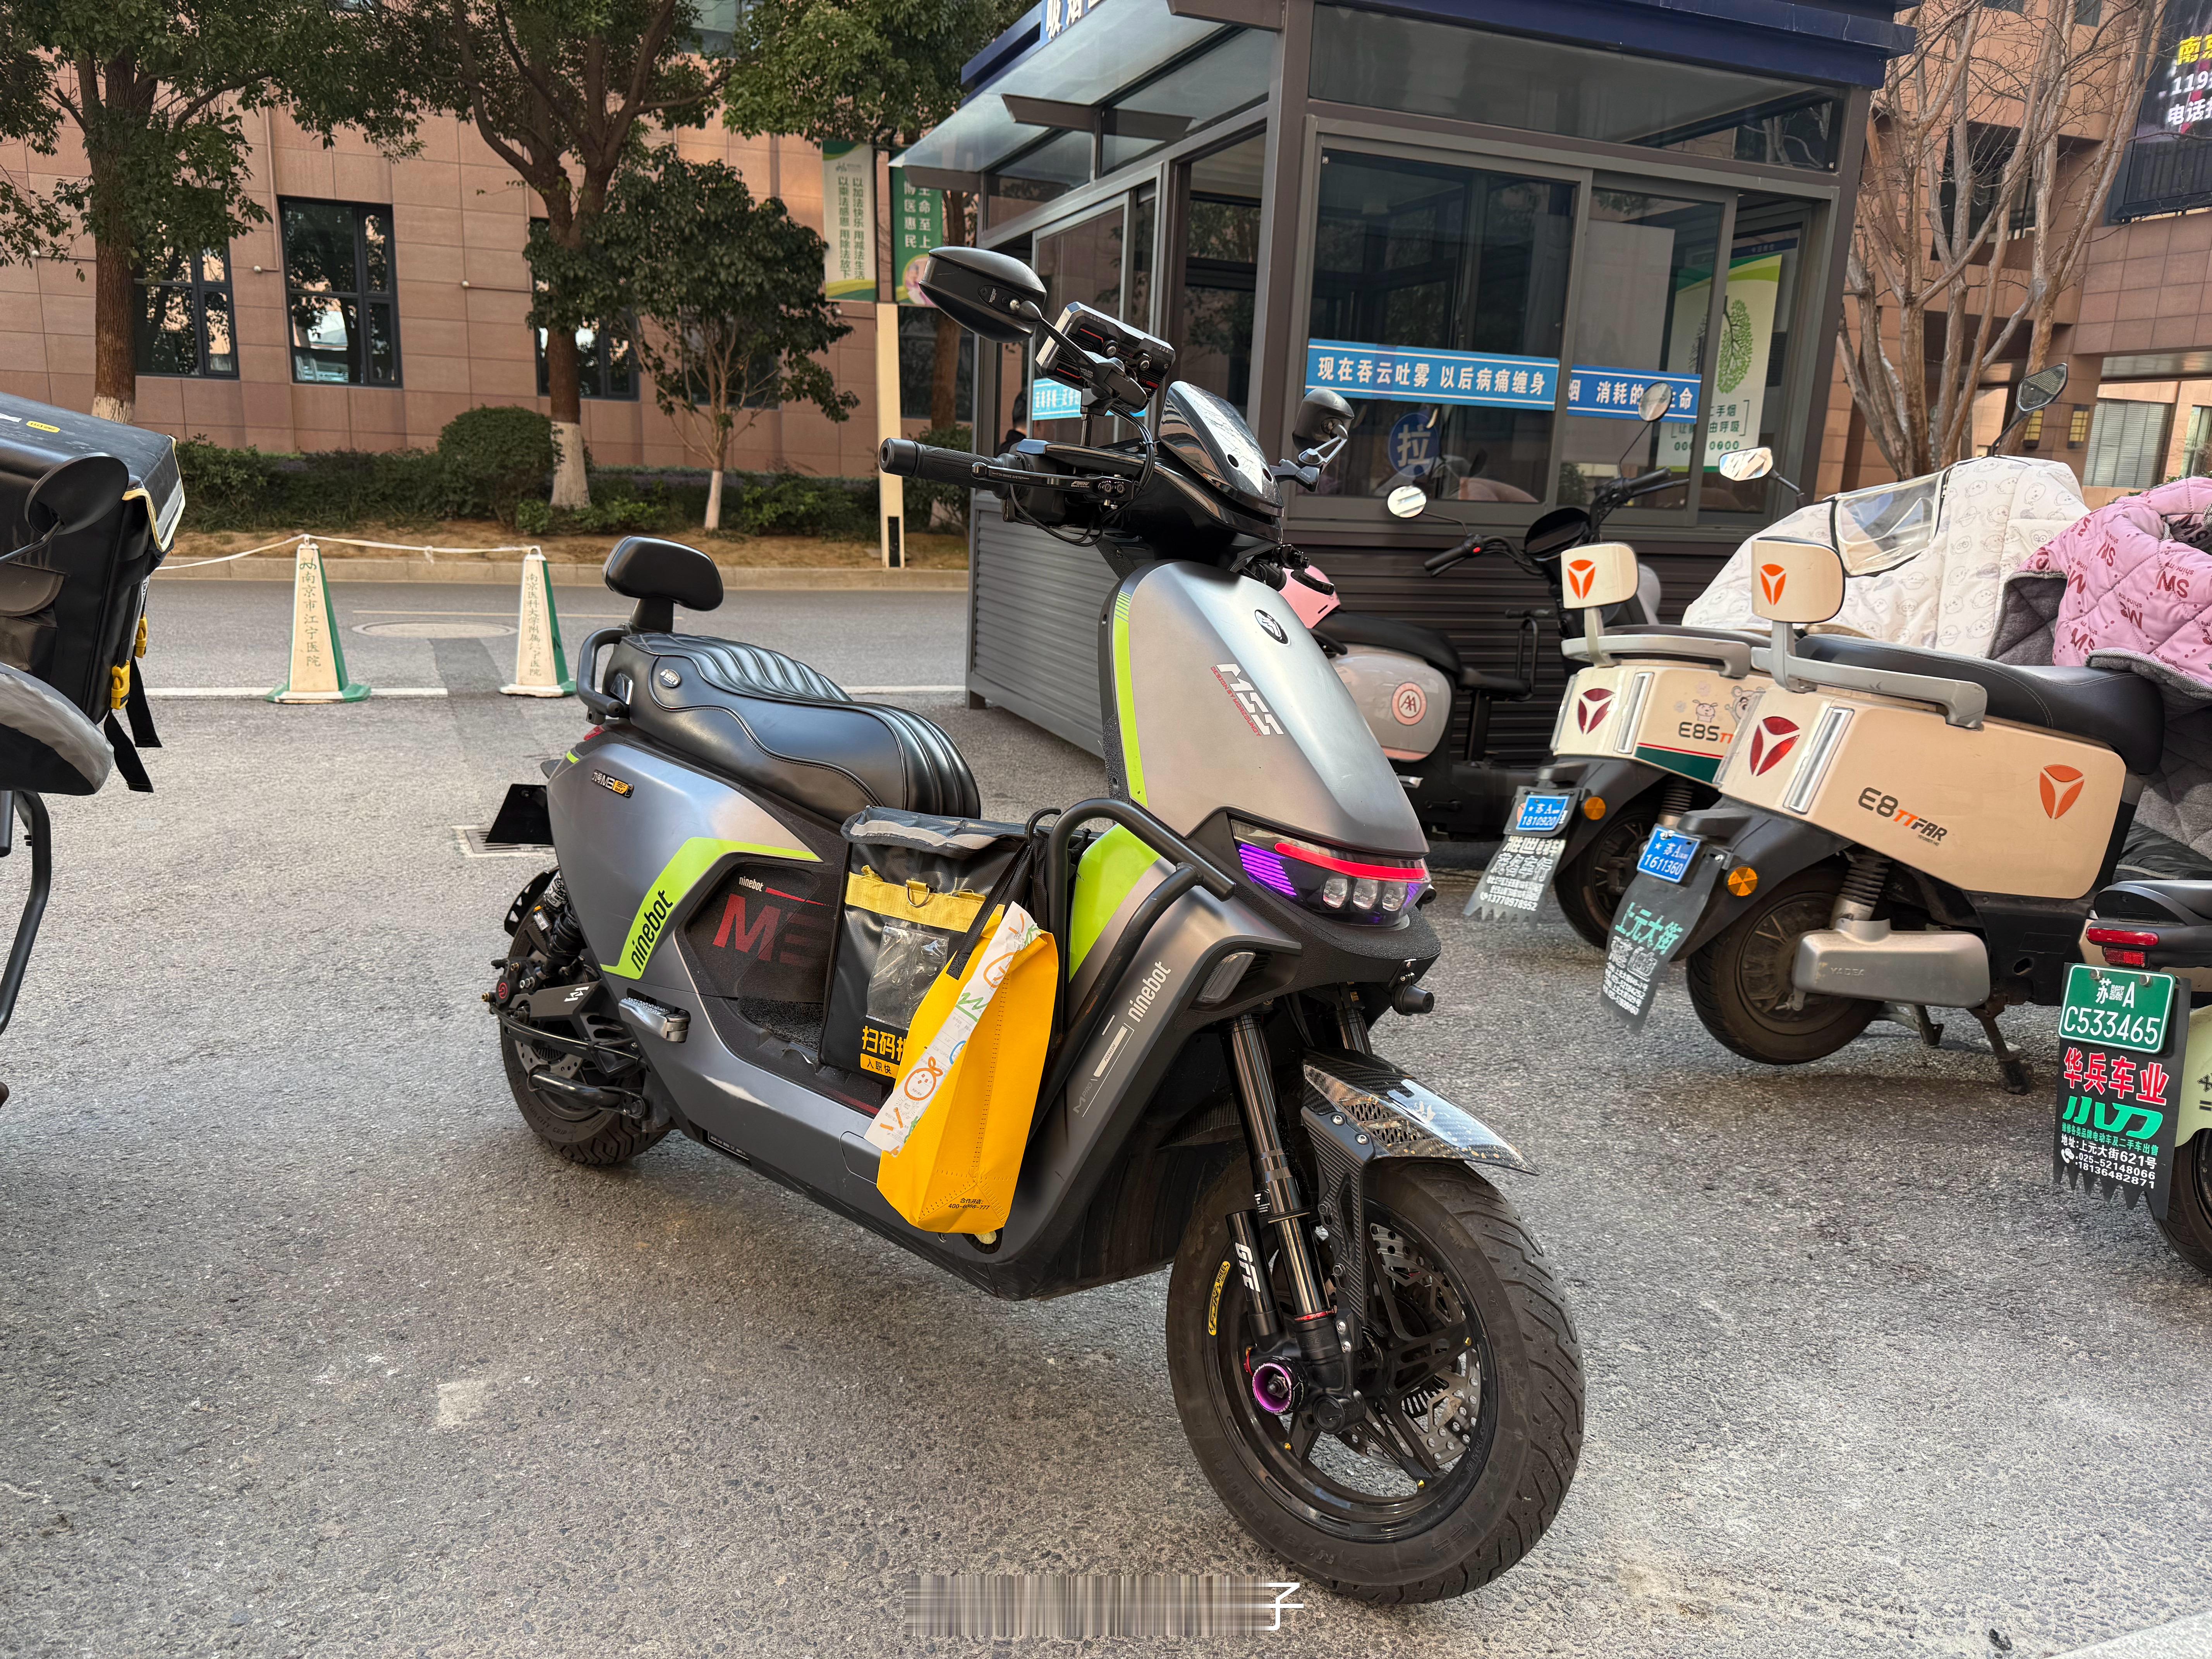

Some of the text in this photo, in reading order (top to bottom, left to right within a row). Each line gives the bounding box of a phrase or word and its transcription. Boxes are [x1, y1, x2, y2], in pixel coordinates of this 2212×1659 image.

[1317, 356, 1545, 396] 现在吞云吐雾 以后病痛缠身
[1397, 424, 1431, 467] 拉
[302, 571, 321, 667] 南京市江宁医院
[1211, 666, 1229, 690] DESIGN
[738, 876, 764, 892] ninebot
[1644, 854, 1684, 876] 1611360
[630, 889, 674, 972] ninebot
[1615, 902, 1683, 955] 上元大街
[1127, 961, 1171, 1023] ninebot
[2095, 978, 2135, 1008] 苏 A
[2063, 1005, 2161, 1045] C533465
[867, 1058, 892, 1075] 入职快
[2063, 1046, 2170, 1106] 华兵车业
[2062, 1122, 2159, 1156] 维修各类品牌电动车及二手车出售
